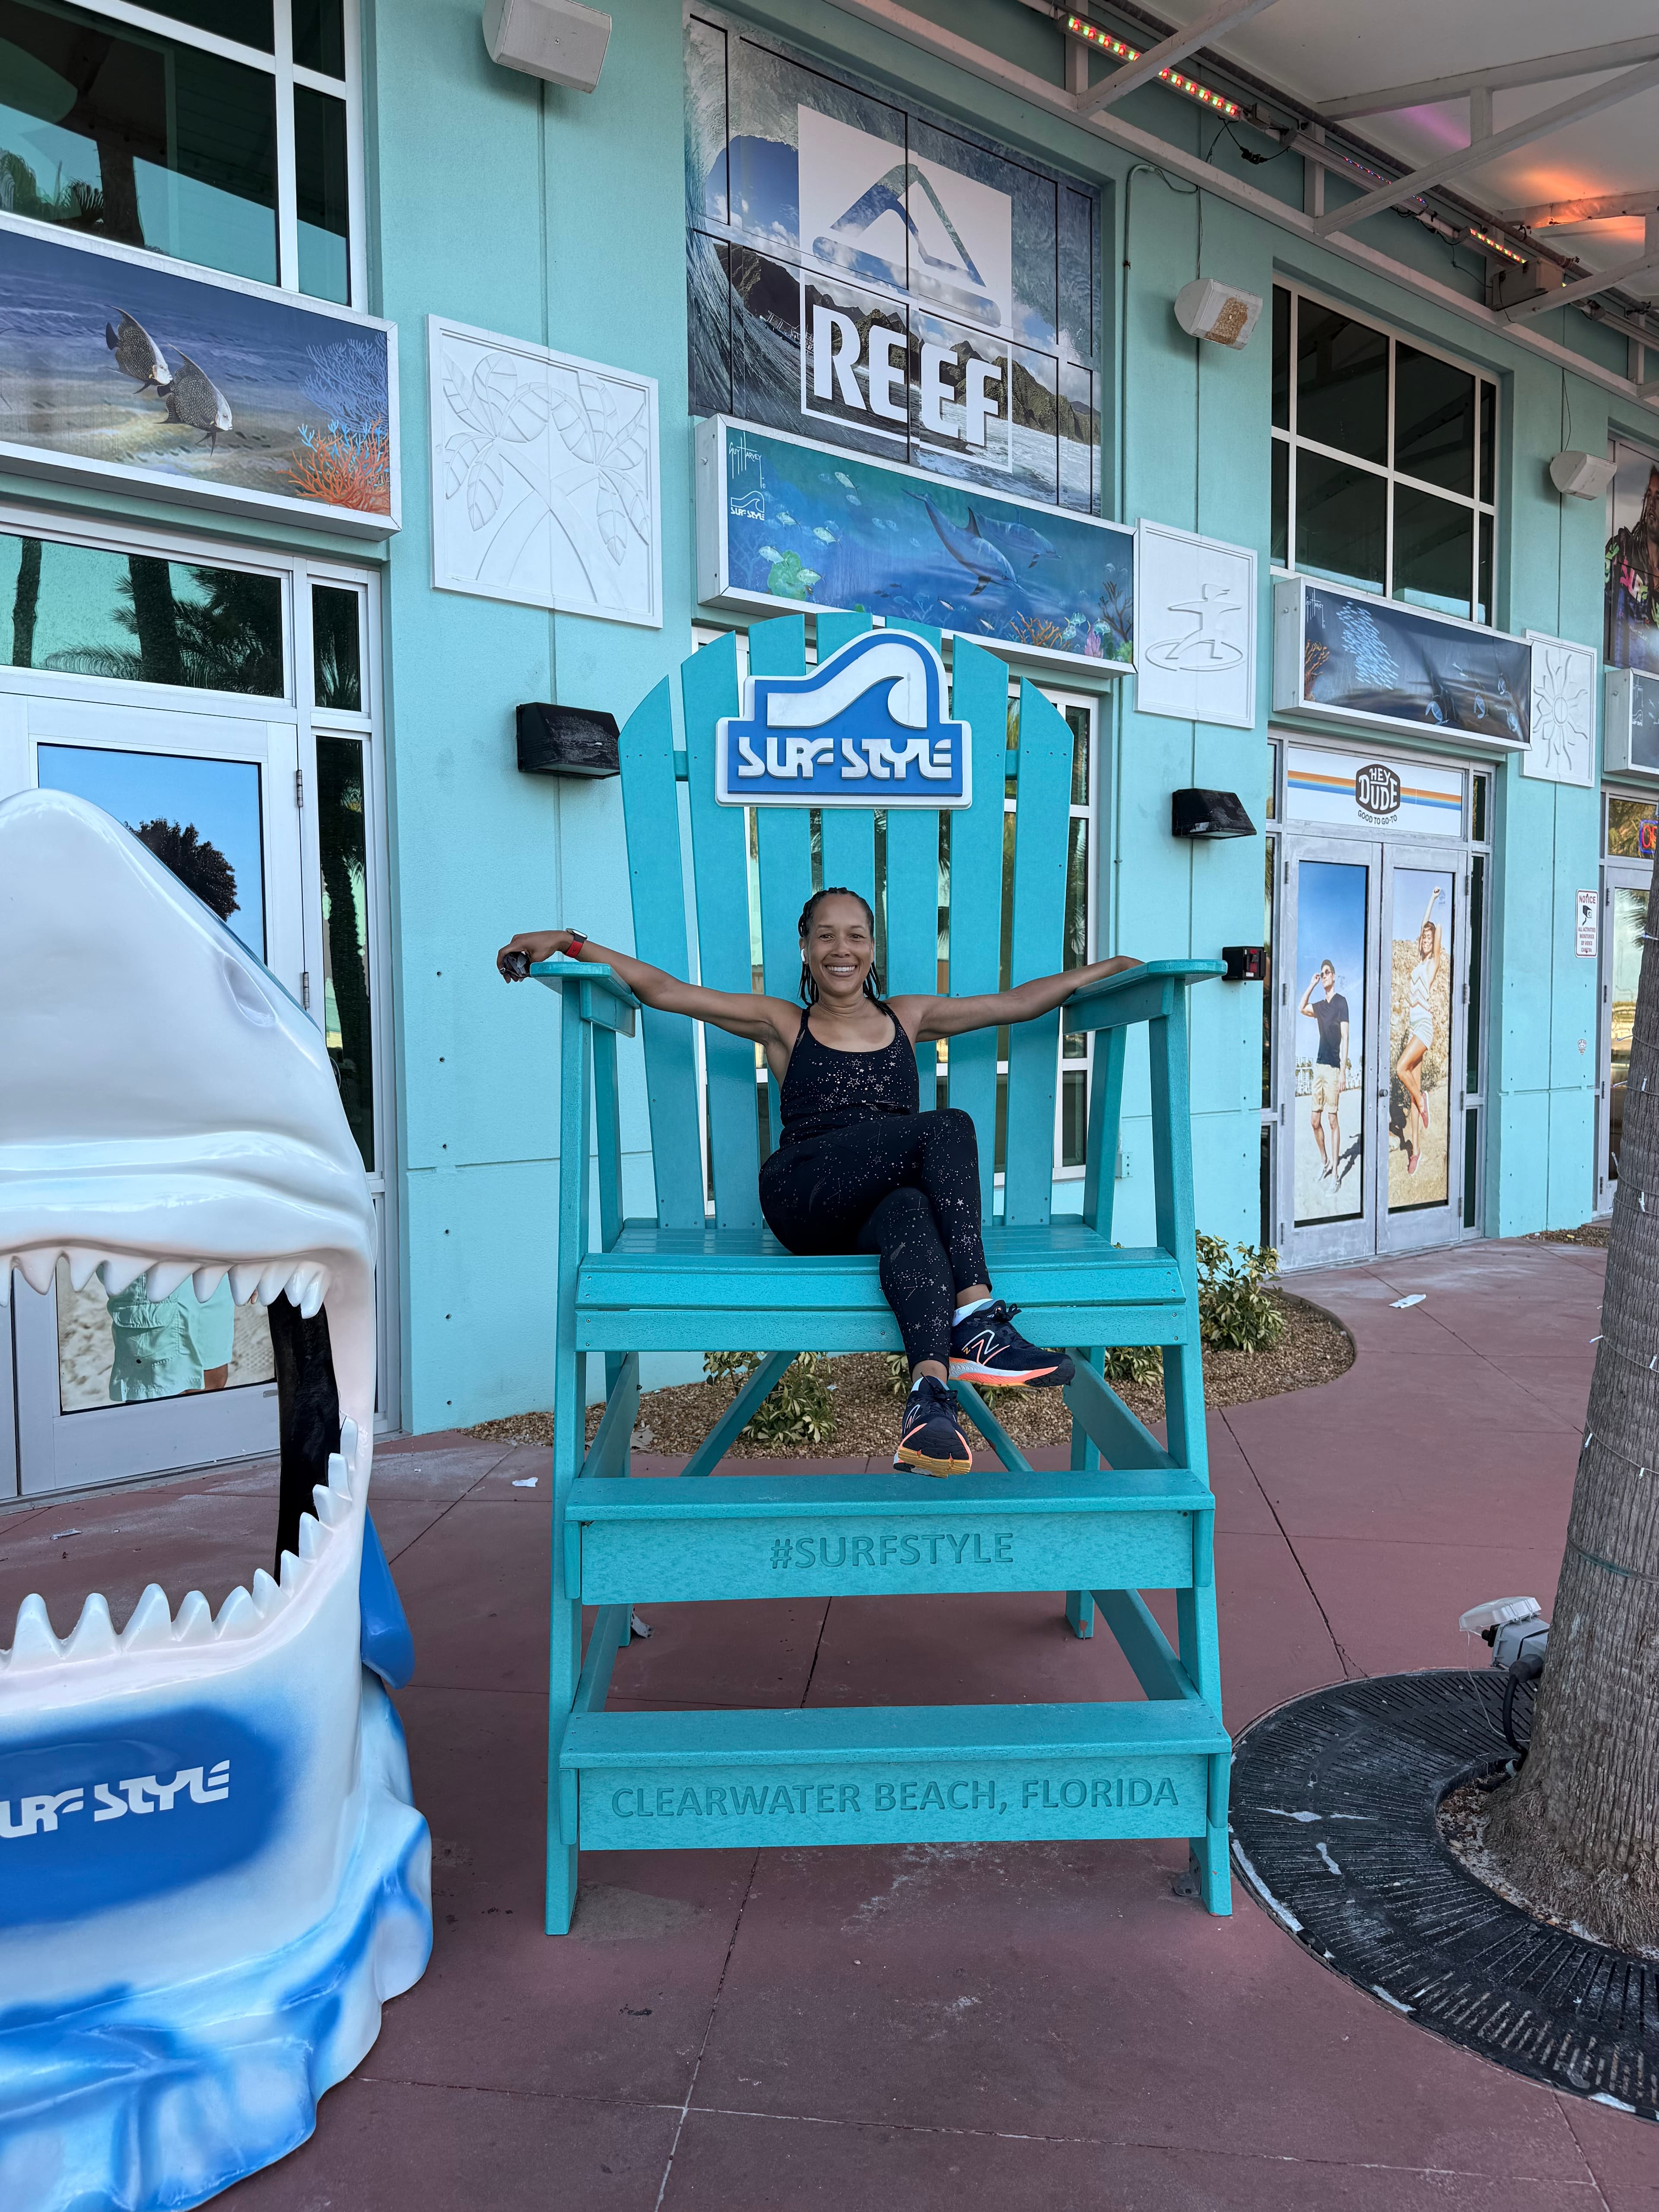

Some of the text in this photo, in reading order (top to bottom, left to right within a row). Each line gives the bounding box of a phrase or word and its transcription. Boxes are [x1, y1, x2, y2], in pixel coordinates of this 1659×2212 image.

[813, 304, 1002, 446] REEF
[747, 512, 765, 521] STYLE
[738, 736, 952, 780] SURF STYLE
[1359, 768, 1398, 810] HEY DUDE
[1358, 810, 1373, 823] GOOD
[1382, 814, 1397, 825] GO-TO
[770, 1533, 1014, 1569] #SURFSTYLE
[94, 1760, 230, 1822] STYLE
[612, 1777, 1179, 1818] CLEARWATER BEACH, FLORIDA
